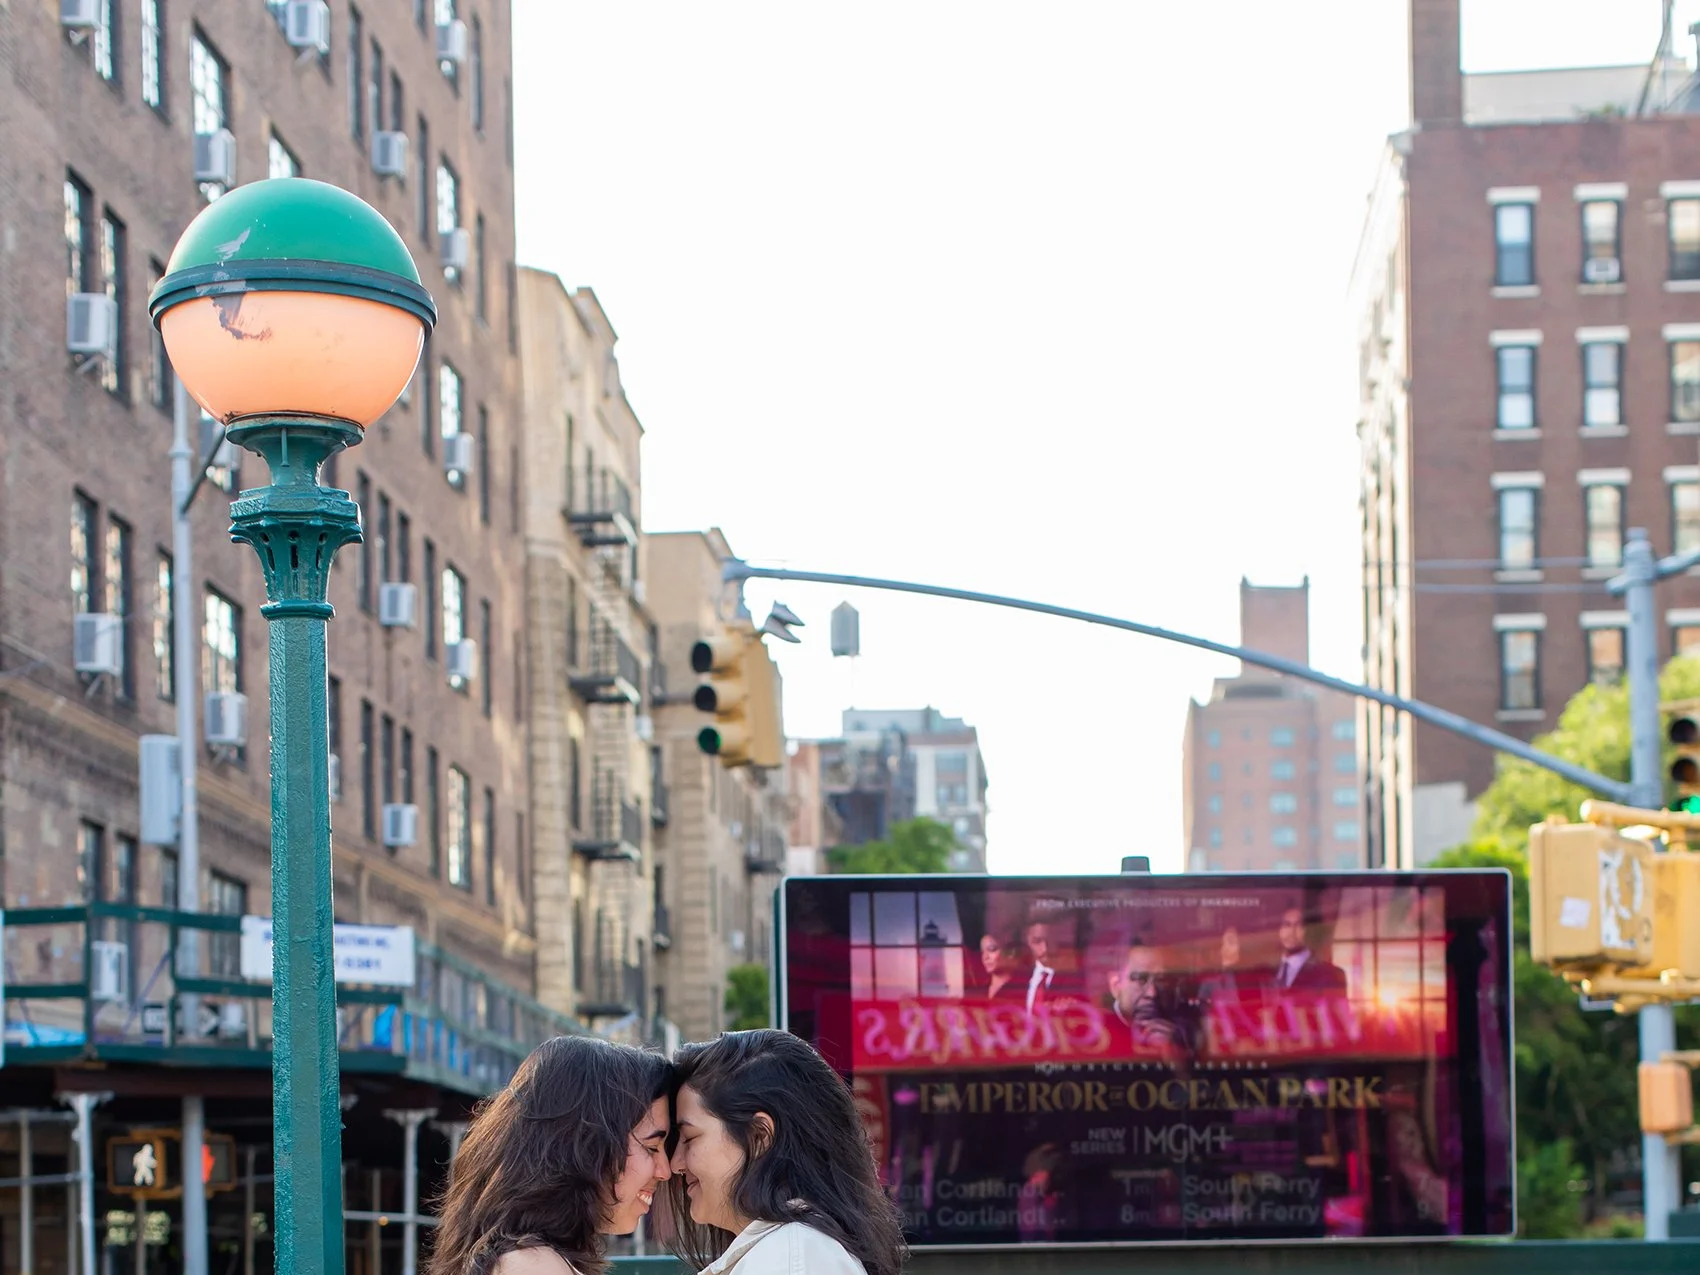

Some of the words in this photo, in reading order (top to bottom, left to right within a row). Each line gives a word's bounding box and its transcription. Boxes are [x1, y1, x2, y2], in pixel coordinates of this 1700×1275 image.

[919, 1080, 1108, 1113] EMPEROR
[1126, 1078, 1268, 1112] OCEAN
[1278, 1076, 1382, 1110] PARK
[1088, 1128, 1126, 1142] NEW
[1144, 1123, 1234, 1162] MGM+
[1070, 1141, 1126, 1155] SERIES
[1261, 1173, 1321, 1198] Ferry
[1261, 1202, 1321, 1225] Ferry
